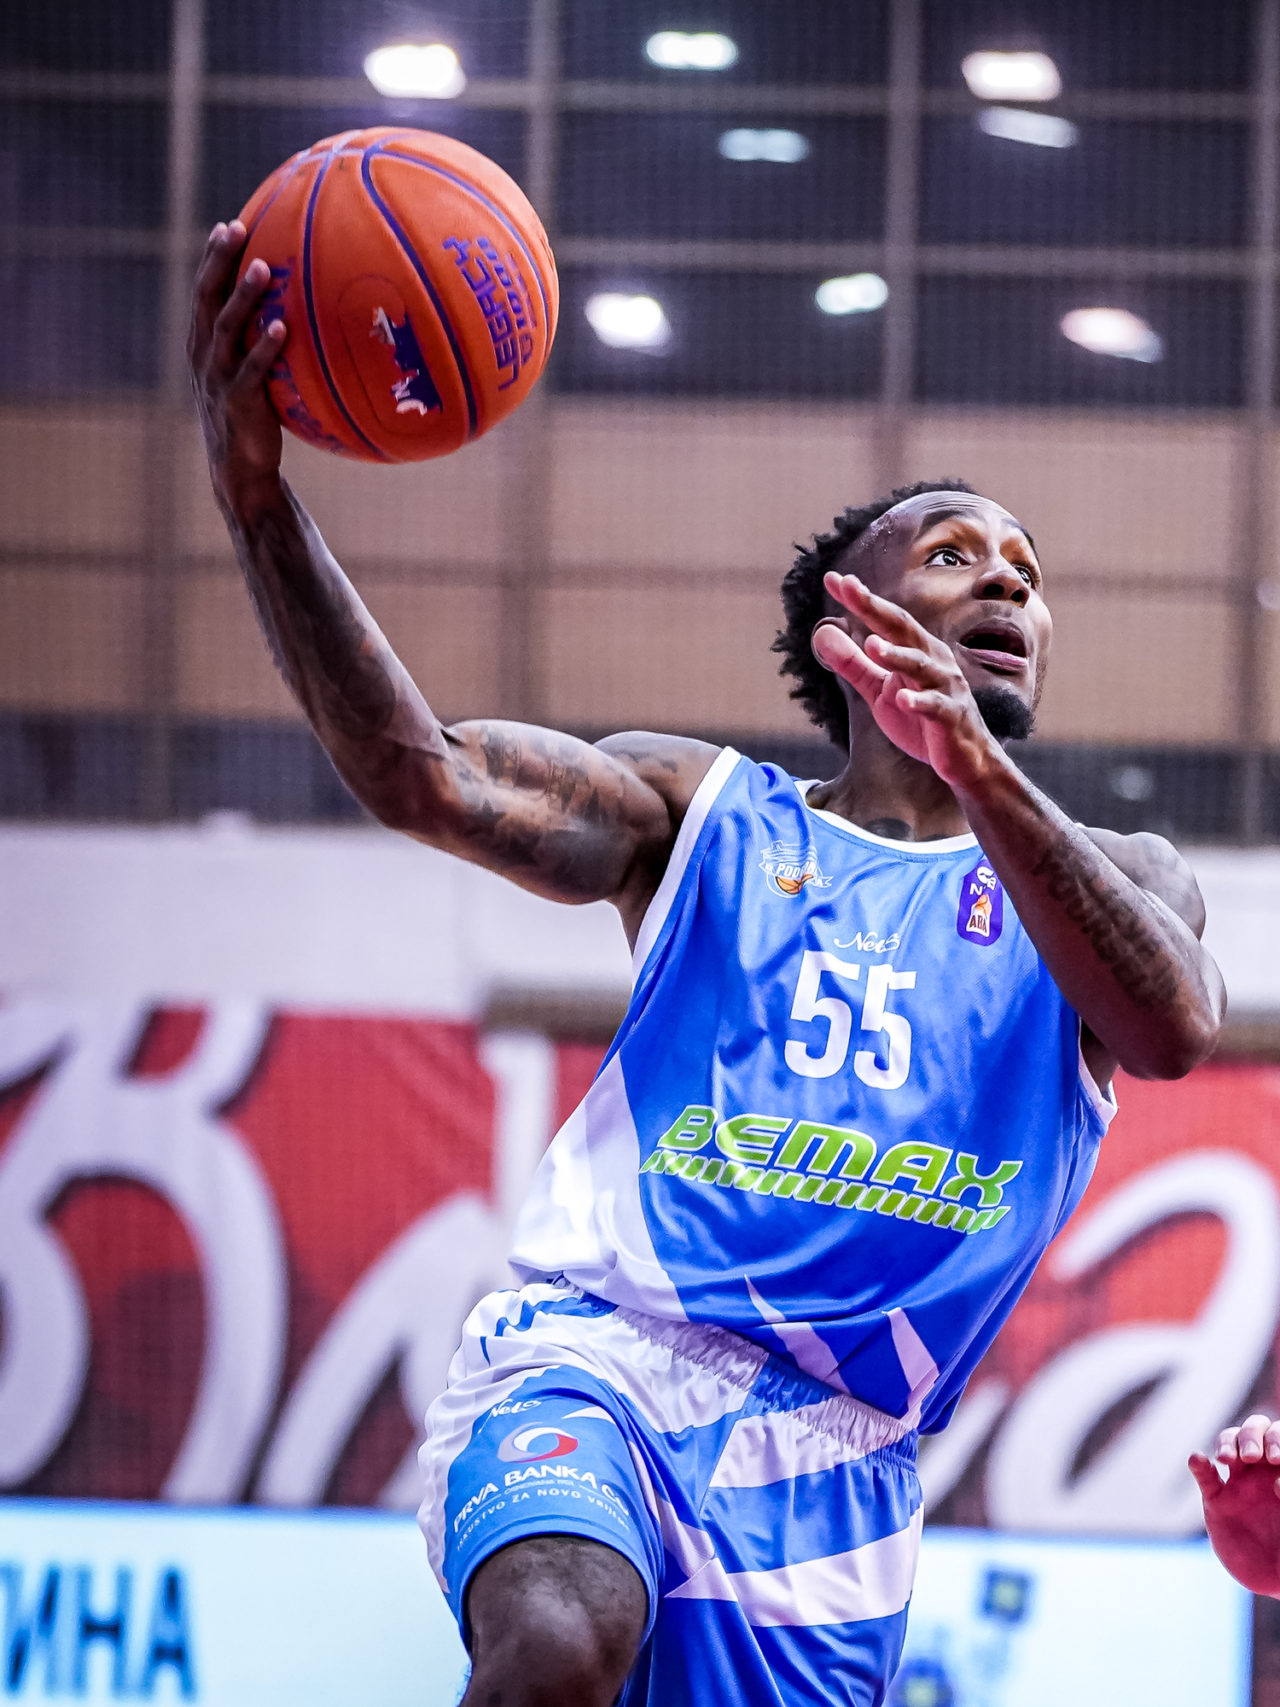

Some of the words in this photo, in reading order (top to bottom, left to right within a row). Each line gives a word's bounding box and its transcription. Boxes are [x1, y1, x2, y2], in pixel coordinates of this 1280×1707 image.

[784, 949, 917, 1090] 55
[656, 1104, 1024, 1208] BEMAX
[453, 1482, 499, 1533] PRVA
[504, 1464, 599, 1489] BANKA
[512, 1492, 530, 1503] ZA
[537, 1488, 581, 1499] NOVO
